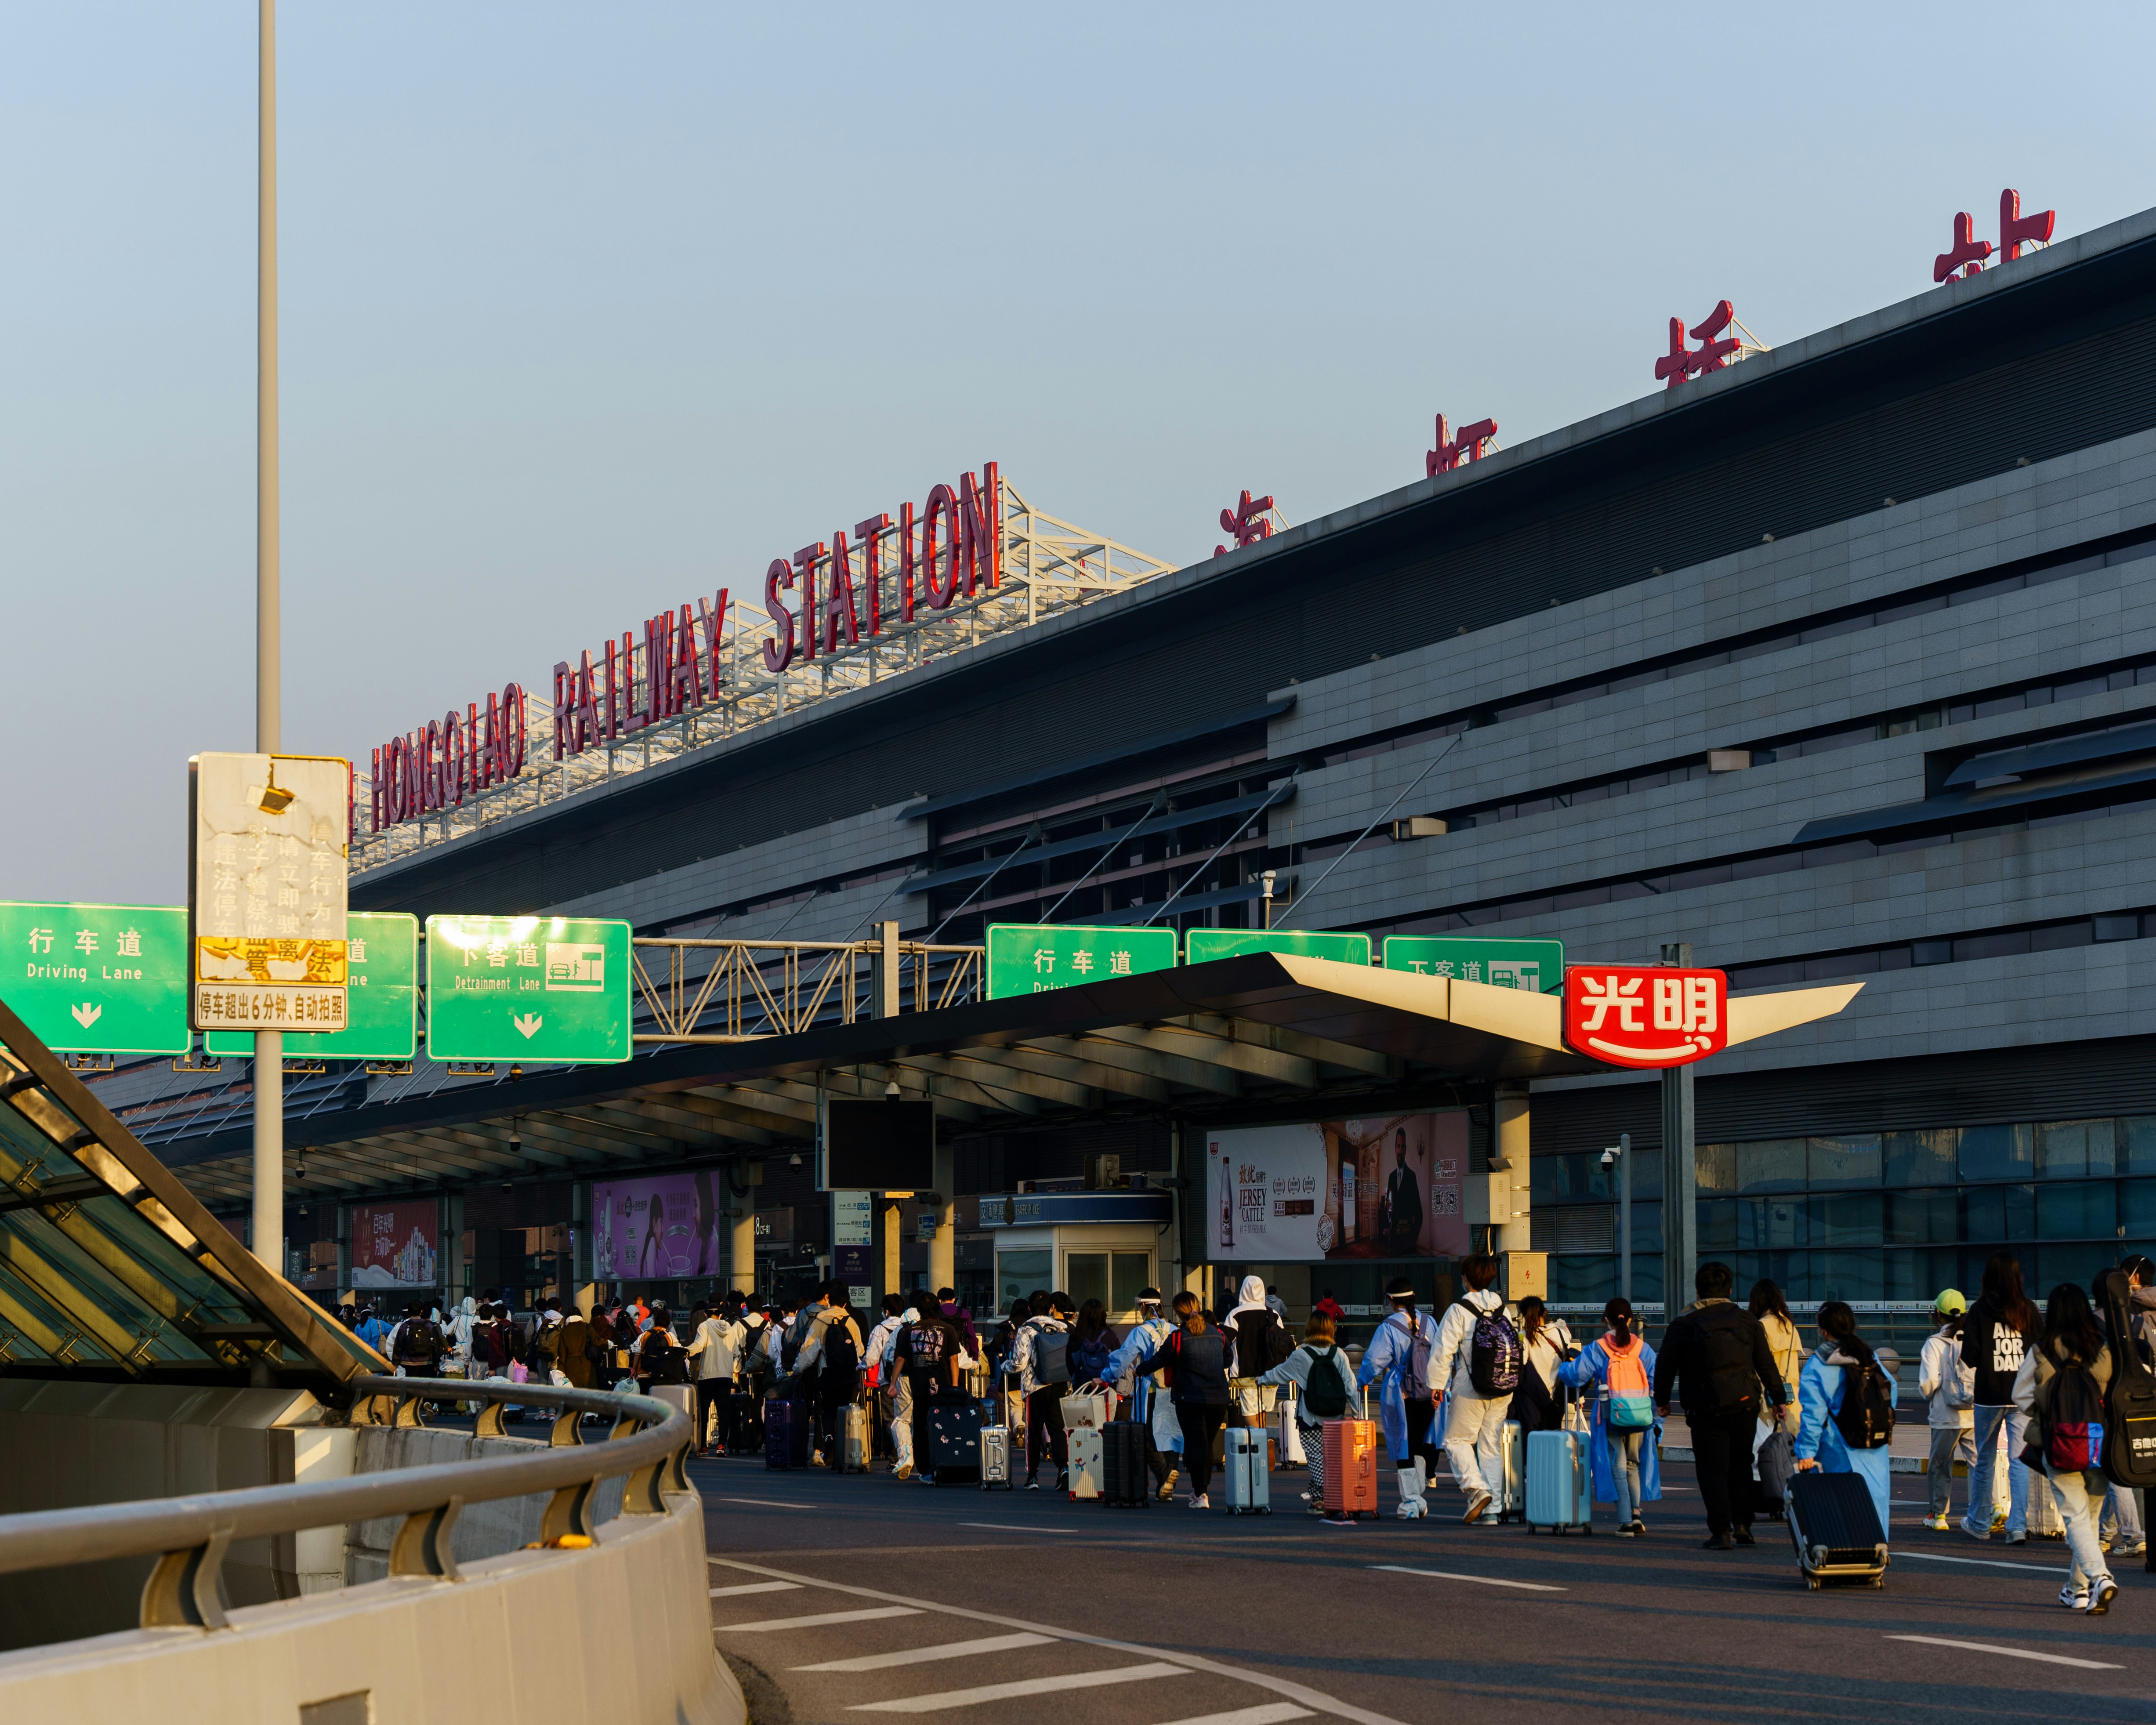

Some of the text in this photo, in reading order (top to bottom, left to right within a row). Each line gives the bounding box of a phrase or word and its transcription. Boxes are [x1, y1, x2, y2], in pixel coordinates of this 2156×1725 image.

[372, 682, 524, 833] HONGQIAO
[554, 588, 728, 761] RAILWAY
[763, 461, 999, 672] STATION
[29, 927, 142, 957] 行车道
[347, 938, 368, 963] 道
[1033, 948, 1132, 975] 行车道
[27, 963, 142, 982] Driving Lane
[350, 975, 368, 986] ne
[455, 975, 540, 990] Detrainment Lane
[199, 992, 342, 1022] 停车超出6分钟、自动拍照
[1581, 975, 1717, 1033] 光明
[1239, 1189, 1267, 1209] JERSEY
[981, 1203, 1004, 1220] 交通警察
[1015, 1204, 1028, 1216] TRAFFIC
[1242, 1207, 1264, 1222] CATTLE
[756, 1217, 760, 1235] 8
[849, 1288, 866, 1296] 客区
[1993, 1338, 2024, 1355] JOR
[1993, 1355, 2025, 1372] DAN
